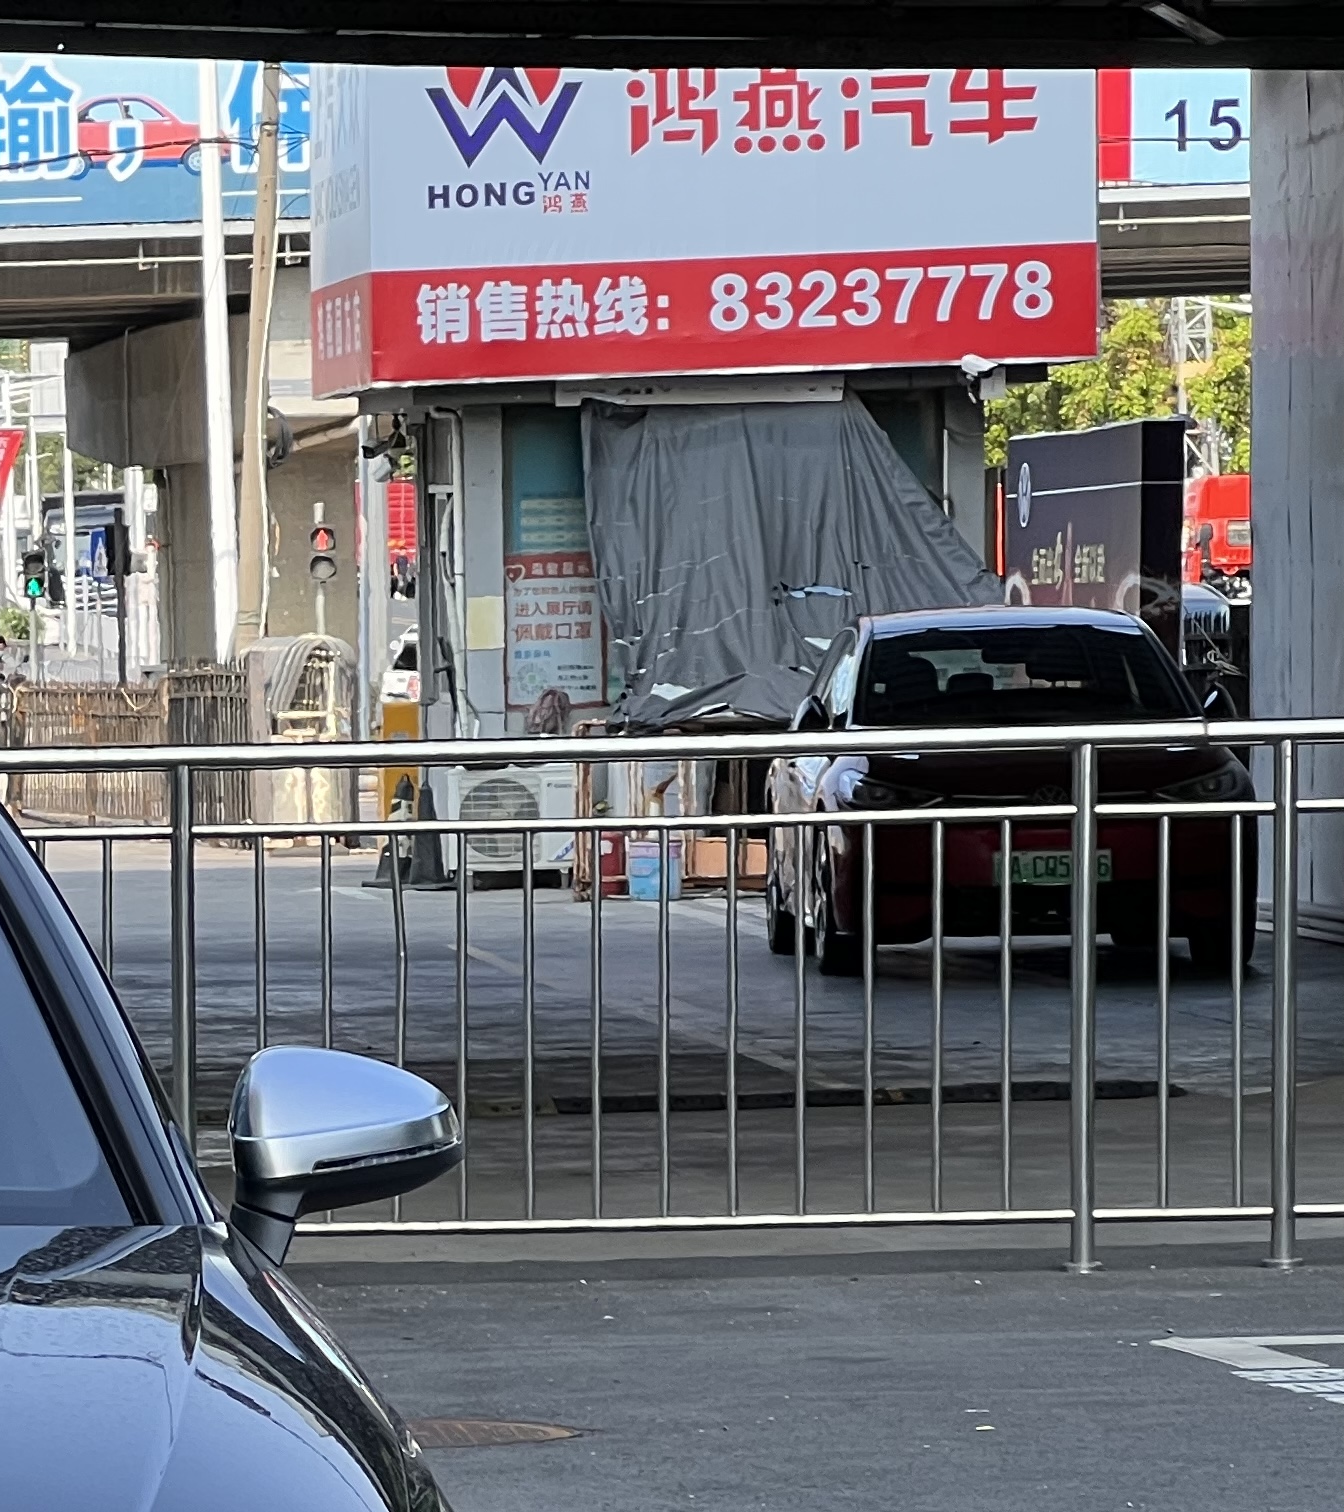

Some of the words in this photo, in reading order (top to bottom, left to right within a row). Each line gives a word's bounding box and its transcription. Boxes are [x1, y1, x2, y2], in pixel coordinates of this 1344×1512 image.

[626, 68, 1039, 156] 鸿燕汽车
[1164, 98, 1242, 152] 15
[427, 181, 535, 210] HONG
[537, 170, 591, 192] YAN
[709, 261, 1054, 332] 83237778
